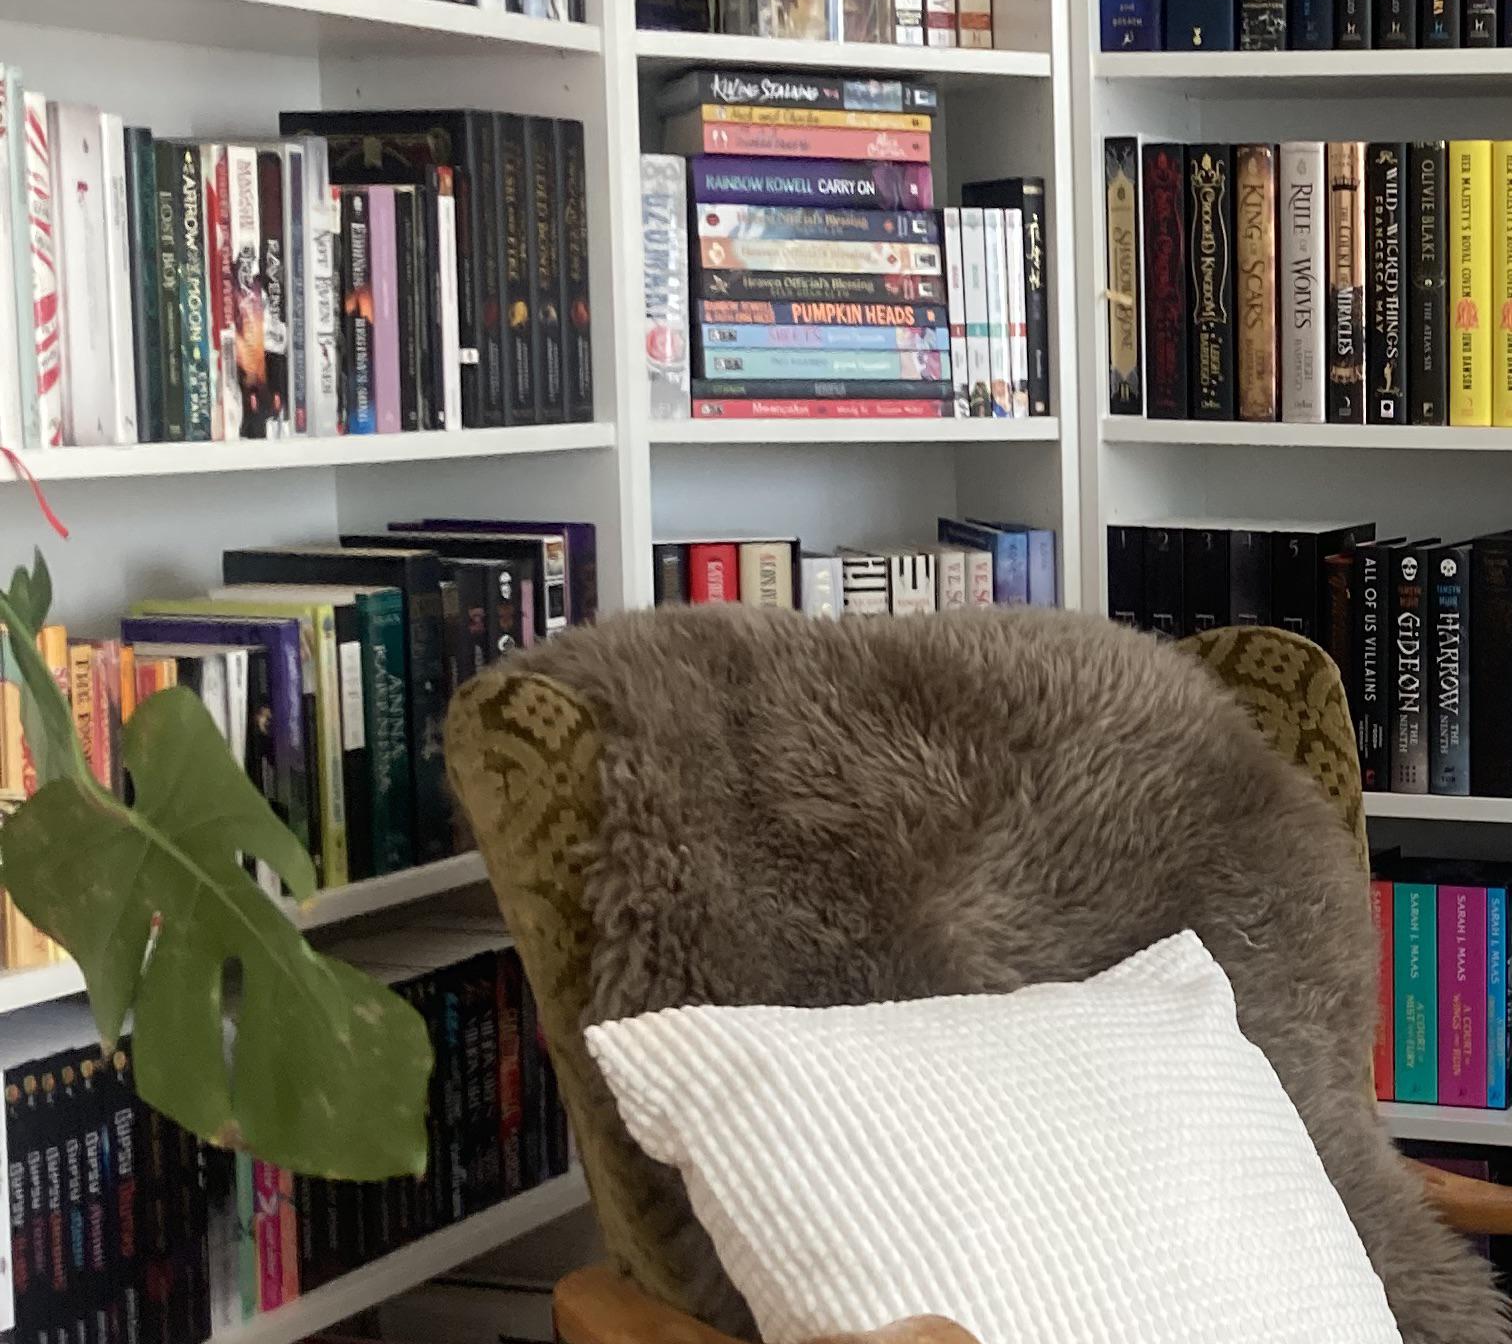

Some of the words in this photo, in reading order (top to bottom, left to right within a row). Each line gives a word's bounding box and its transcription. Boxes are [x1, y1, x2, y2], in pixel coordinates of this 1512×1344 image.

[817, 176, 853, 195] CARRY
[856, 178, 876, 195] ON
[1421, 160, 1435, 211] OLIVIE
[1421, 216, 1435, 261] BLAKE
[792, 303, 861, 323] PUMPKIN
[865, 304, 915, 324] HEADS
[1364, 557, 1377, 582] ALL
[1364, 588, 1377, 607] OF
[1364, 614, 1377, 631] US
[1364, 637, 1377, 701] VILLAINS
[1437, 611, 1460, 712] HARROW
[1457, 895, 1466, 933] SARAH
